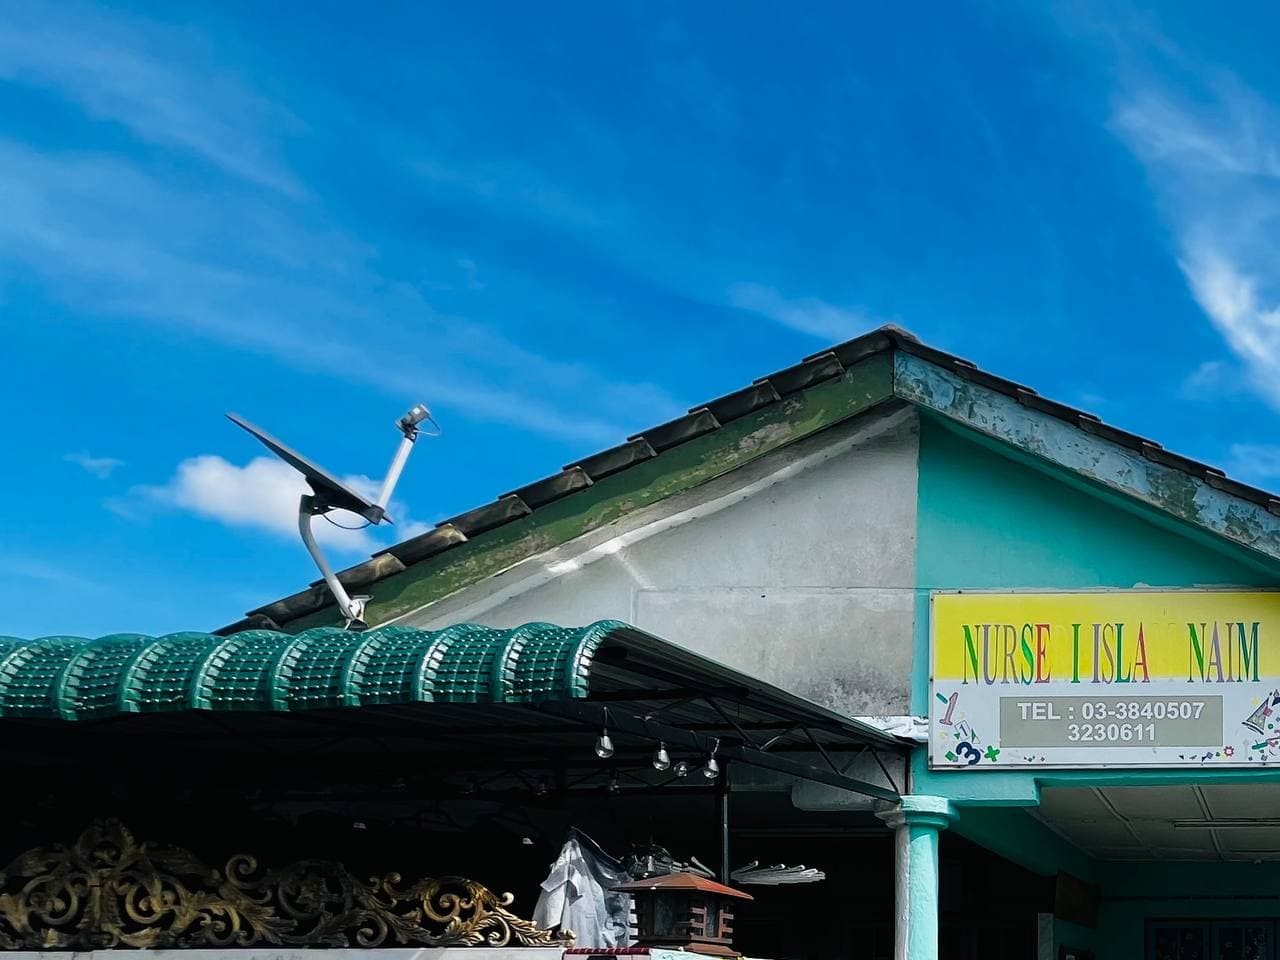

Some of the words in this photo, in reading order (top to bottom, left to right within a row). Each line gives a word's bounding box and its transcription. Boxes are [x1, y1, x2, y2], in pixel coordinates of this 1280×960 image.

[1186, 620, 1261, 685] NAIM
[1017, 702, 1061, 720] TEL
[1081, 702, 1205, 720] 03-3840507
[1068, 723, 1156, 742] 3230611
